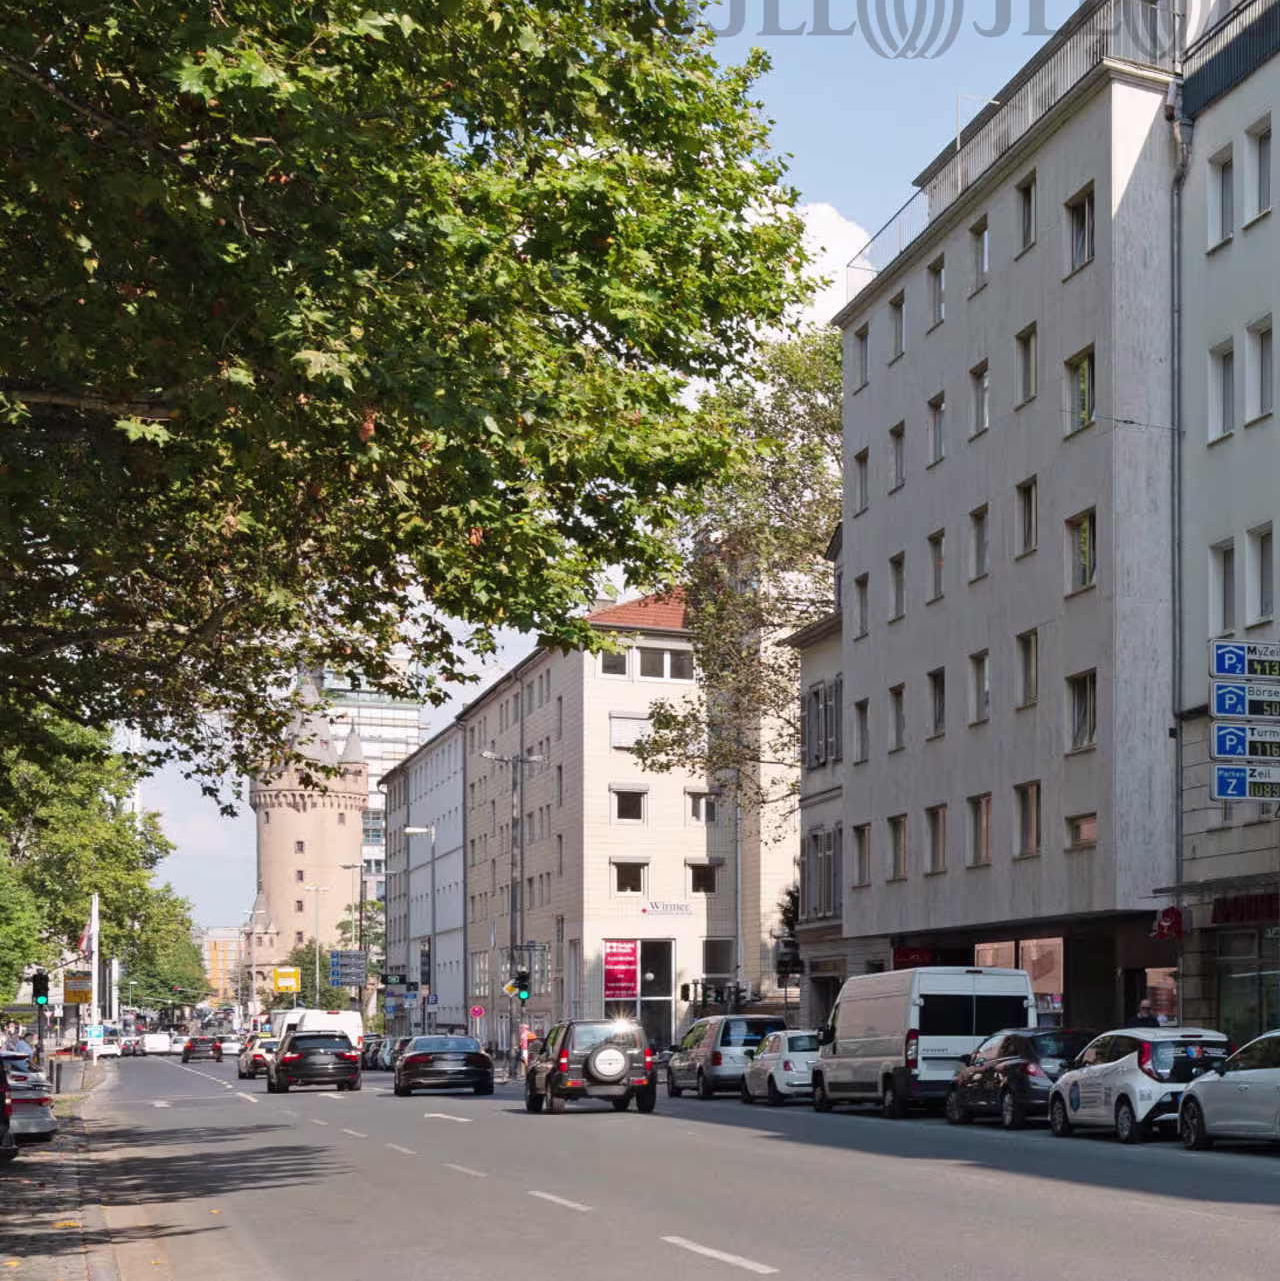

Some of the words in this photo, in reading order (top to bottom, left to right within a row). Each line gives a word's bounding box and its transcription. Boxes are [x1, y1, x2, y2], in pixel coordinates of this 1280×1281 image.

[1225, 654, 1237, 670] P
[1248, 686, 1280, 698] Börse
[1225, 694, 1237, 710] P
[1263, 702, 1280, 716] 50
[1226, 735, 1237, 751] P
[1248, 768, 1271, 779] Zeil
[1226, 779, 1238, 794] Z
